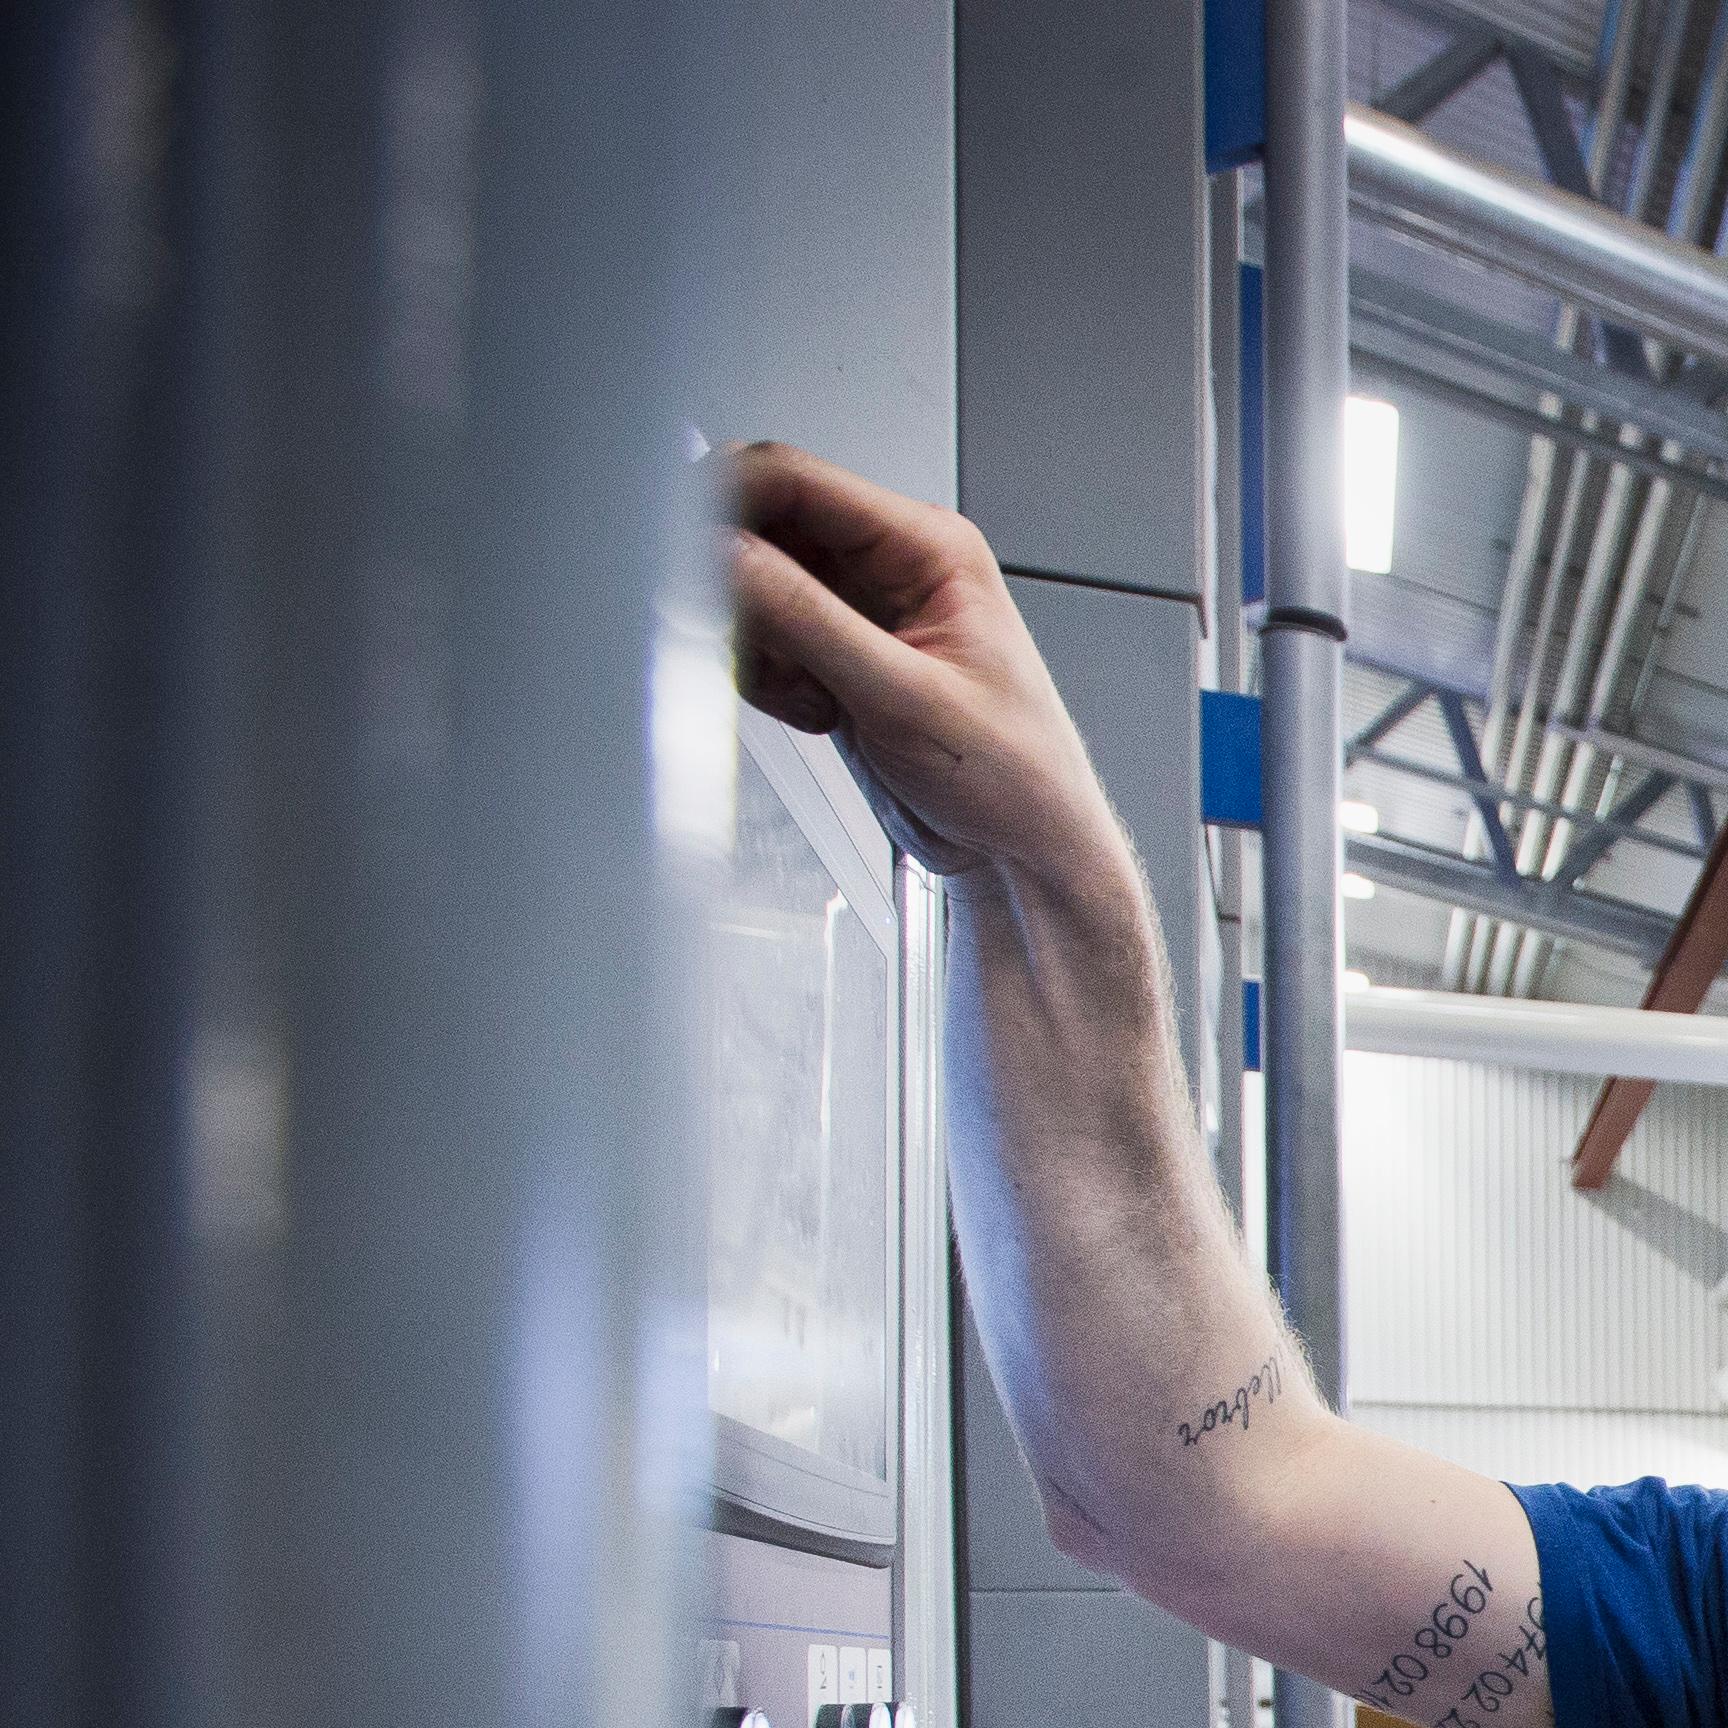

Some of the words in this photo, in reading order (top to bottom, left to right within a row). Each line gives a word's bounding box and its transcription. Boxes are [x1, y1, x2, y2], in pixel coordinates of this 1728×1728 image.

[1414, 1559, 1493, 1658] 1998
[1499, 1584, 1545, 1676] 74
[1373, 1654, 1428, 1696] 02
[1460, 1671, 1513, 1713] 02
